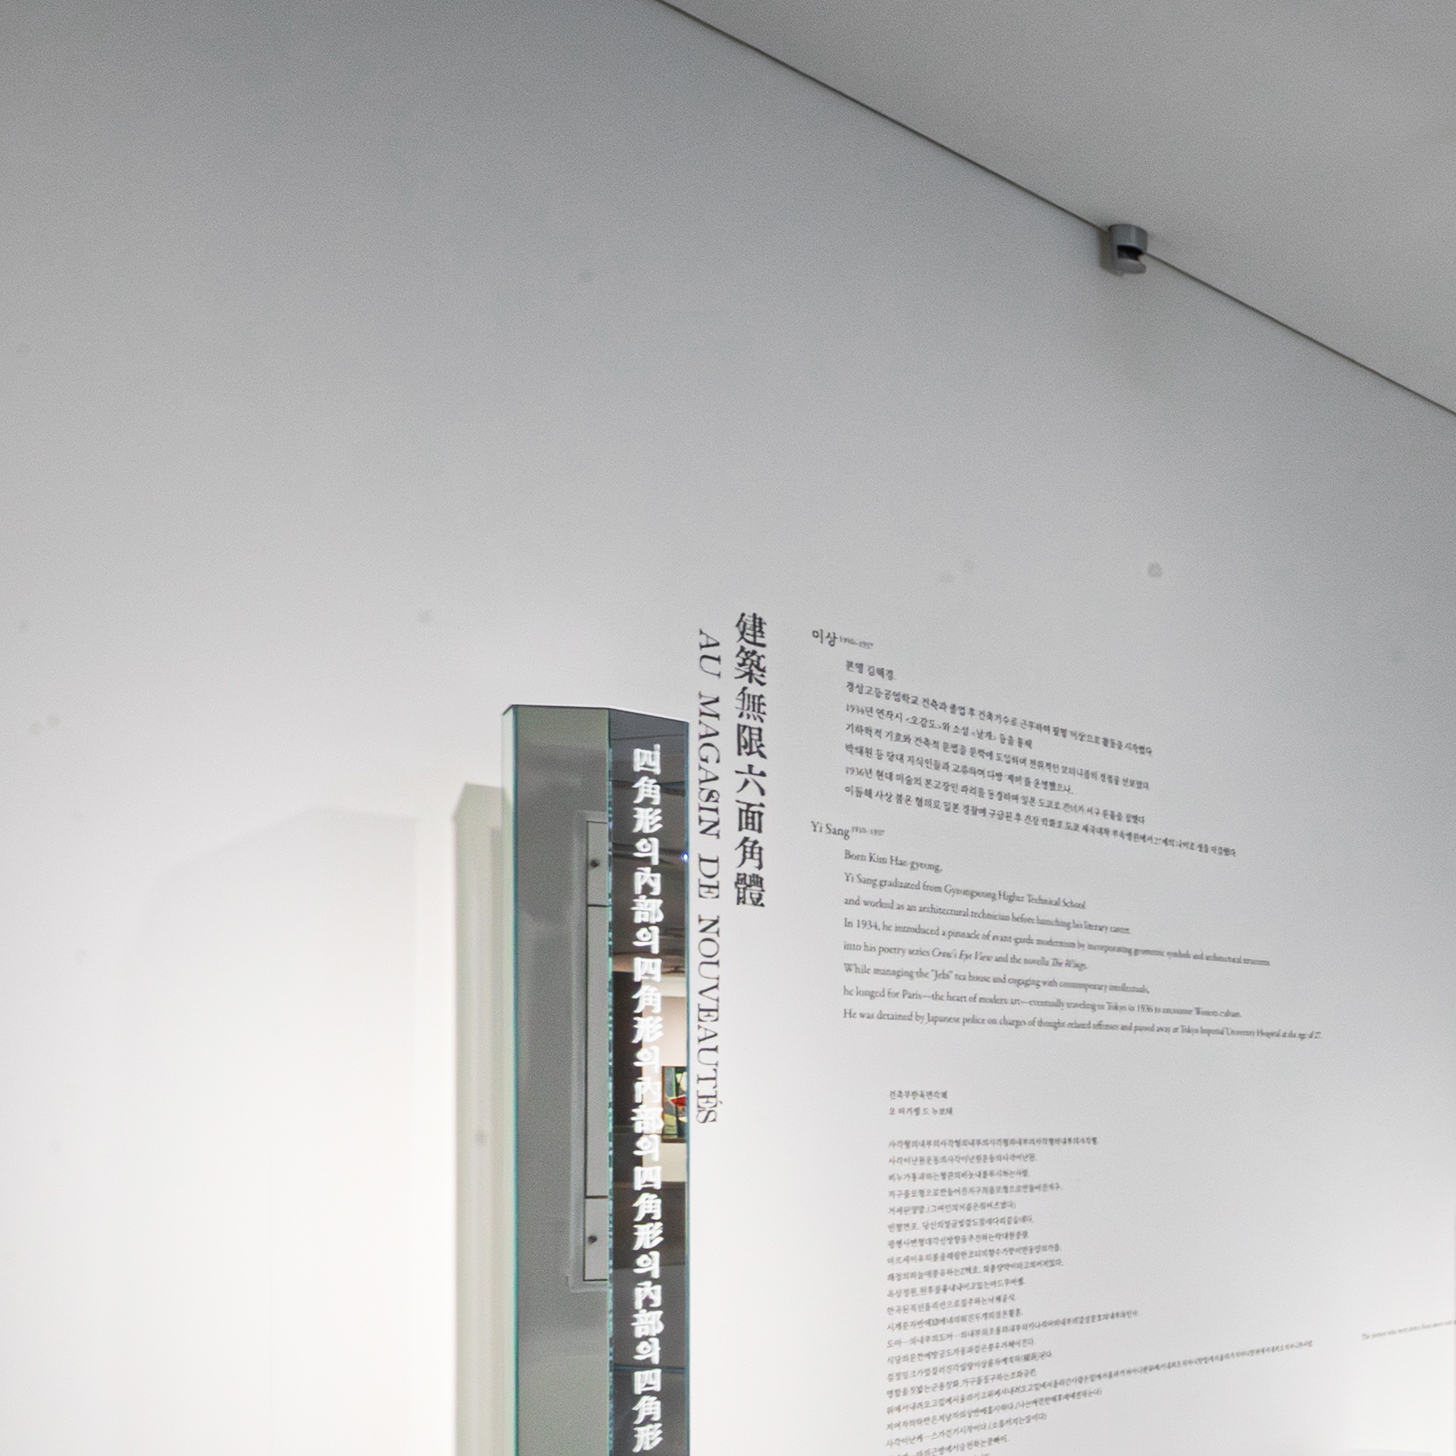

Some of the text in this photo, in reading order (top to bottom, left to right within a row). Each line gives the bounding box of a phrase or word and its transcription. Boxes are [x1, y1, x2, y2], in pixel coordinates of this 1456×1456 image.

[811, 628, 837, 648] 이상
[846, 703, 874, 718] 1934년
[876, 708, 903, 723] 연작시
[952, 724, 970, 737] 소설
[921, 697, 948, 712] 건축과
[949, 703, 966, 717] 졸업
[846, 722, 882, 740] 기하학적
[734, 612, 767, 908] 建築無限六面角體
[845, 742, 1003, 782] 박태원 등 당대 지식인들과 다방
[845, 766, 873, 779] 1936년
[876, 769, 894, 782] 현대
[924, 778, 959, 794] 본고장인
[1020, 795, 1036, 807] 일본
[844, 784, 873, 800] 이듬해
[875, 789, 893, 804] 사상
[943, 801, 960, 814] 일본
[961, 804, 987, 818] 경찰에
[988, 808, 1014, 823] 구금된
[810, 820, 851, 841] Yi Sang
[843, 848, 867, 862] Born
[867, 851, 888, 865] Kim
[696, 628, 723, 1126] AU MAGASIN DE NOUVEAUTÉS
[843, 871, 1087, 910] Yi Sang graduated from Higher Technical School
[843, 895, 861, 907] and
[862, 898, 895, 910] worked
[895, 903, 905, 911] as
[905, 904, 918, 912] an
[917, 903, 970, 918] architectural
[969, 908, 1010, 922] technician
[1010, 912, 1035, 924] before
[1083, 920, 1109, 932] literary
[843, 917, 854, 928] In
[855, 919, 881, 932] 1934,
[881, 920, 893, 932] he
[893, 924, 940, 937] introduced
[946, 929, 981, 940] pinnacle
[980, 930, 992, 941] of
[842, 943, 862, 952] into
[862, 941, 877, 952] his
[877, 945, 907, 957] poetry
[907, 948, 930, 957] series
[958, 949, 973, 961] Eye
[973, 950, 993, 962] View
[993, 953, 1009, 964] and
[1009, 954, 1022, 965] the
[1021, 956, 1050, 967] novella
[1050, 957, 1063, 968] The
[842, 962, 871, 975] While
[871, 968, 915, 981] managing
[914, 967, 930, 979] the
[953, 973, 967, 982] tea
[967, 971, 991, 983] house
[991, 974, 1007, 984] and
[1007, 977, 1041, 990] engaging
[1040, 978, 1058, 988] with
[842, 984, 854, 997] he
[854, 986, 886, 1001] longed
[886, 988, 900, 998] for
[945, 991, 968, 1003] heart
[967, 993, 979, 1003] of
[978, 994, 1009, 1005] modern
[842, 1008, 858, 1019] He
[858, 1012, 875, 1020] was
[875, 1009, 914, 1022] detained
[914, 1011, 925, 1024] by
[924, 1012, 961, 1026] Japanese
[961, 1014, 986, 1027] police
[998, 1015, 1027, 1030] charges
[1026, 1016, 1037, 1027] of
